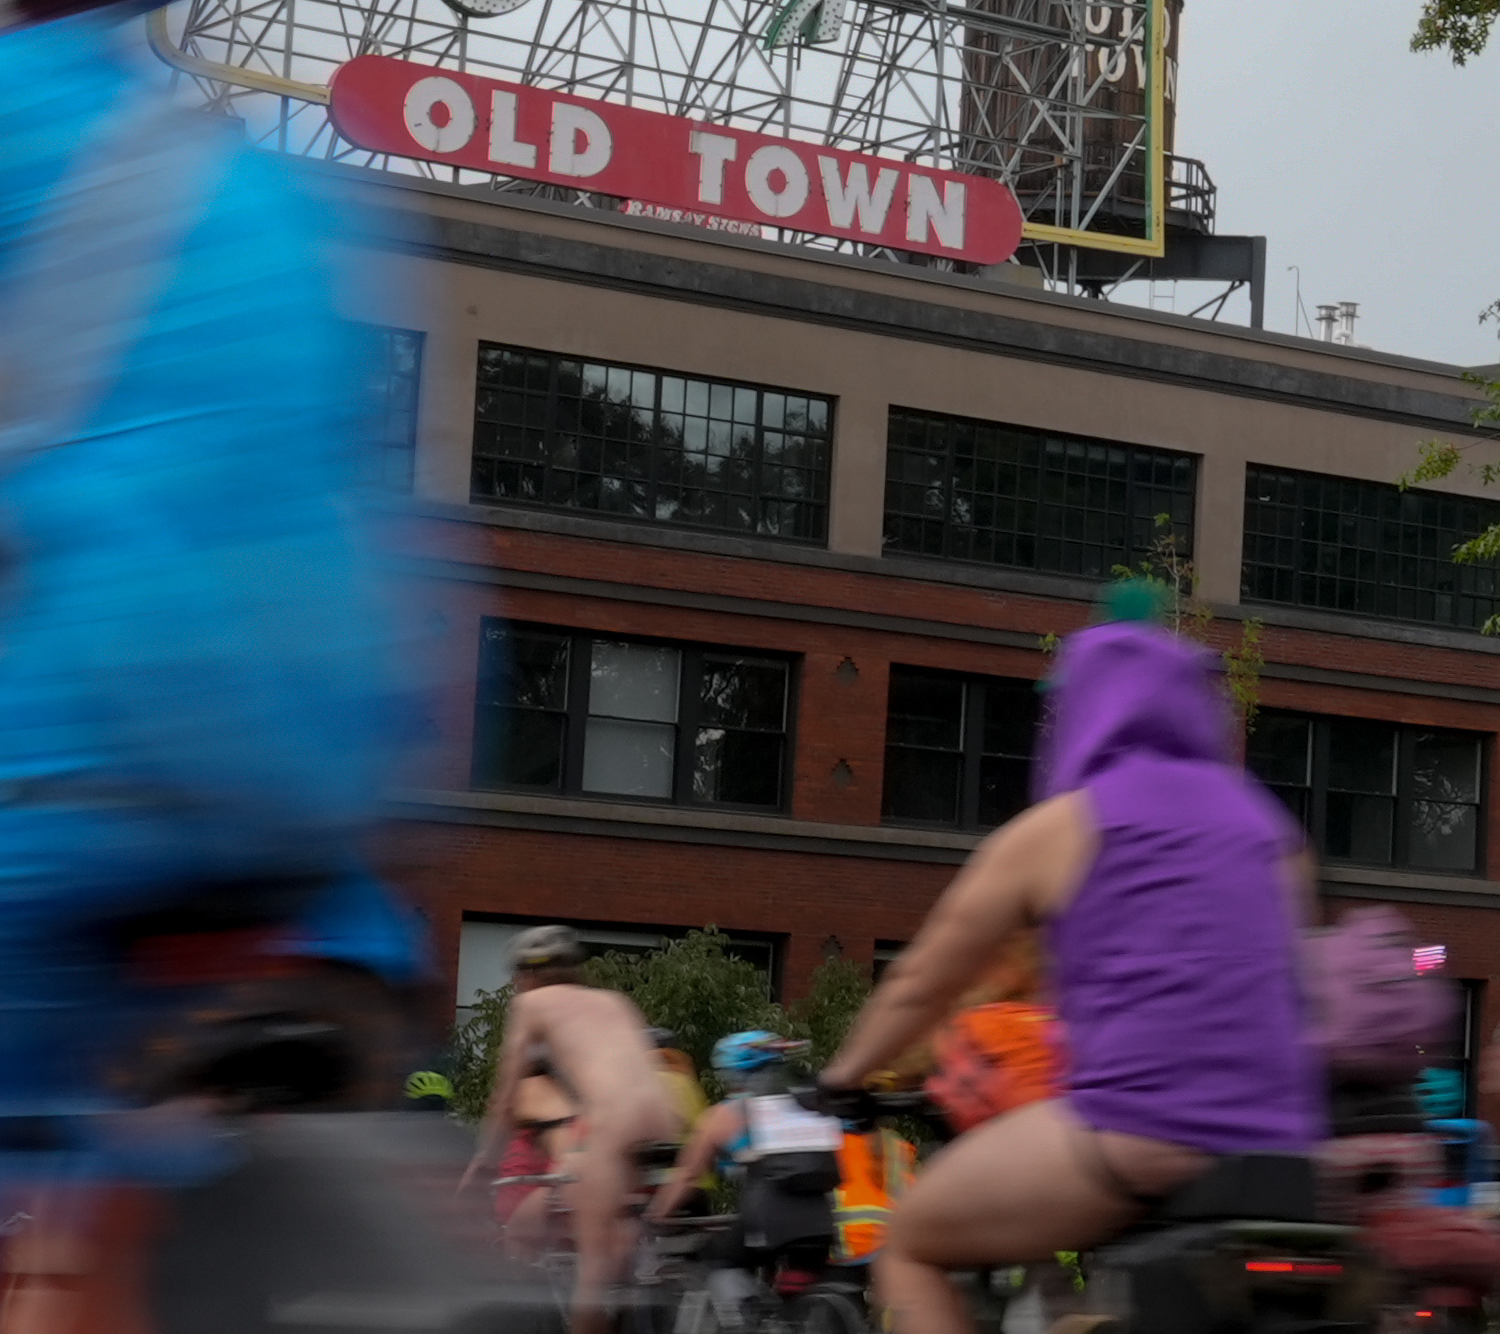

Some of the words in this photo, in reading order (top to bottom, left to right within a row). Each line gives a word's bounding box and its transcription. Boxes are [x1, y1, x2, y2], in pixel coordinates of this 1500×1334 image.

[403, 75, 614, 178] OLD
[689, 129, 966, 251] TOWN
[625, 199, 705, 226] RAMSAY
[706, 215, 760, 237] SIGNS
